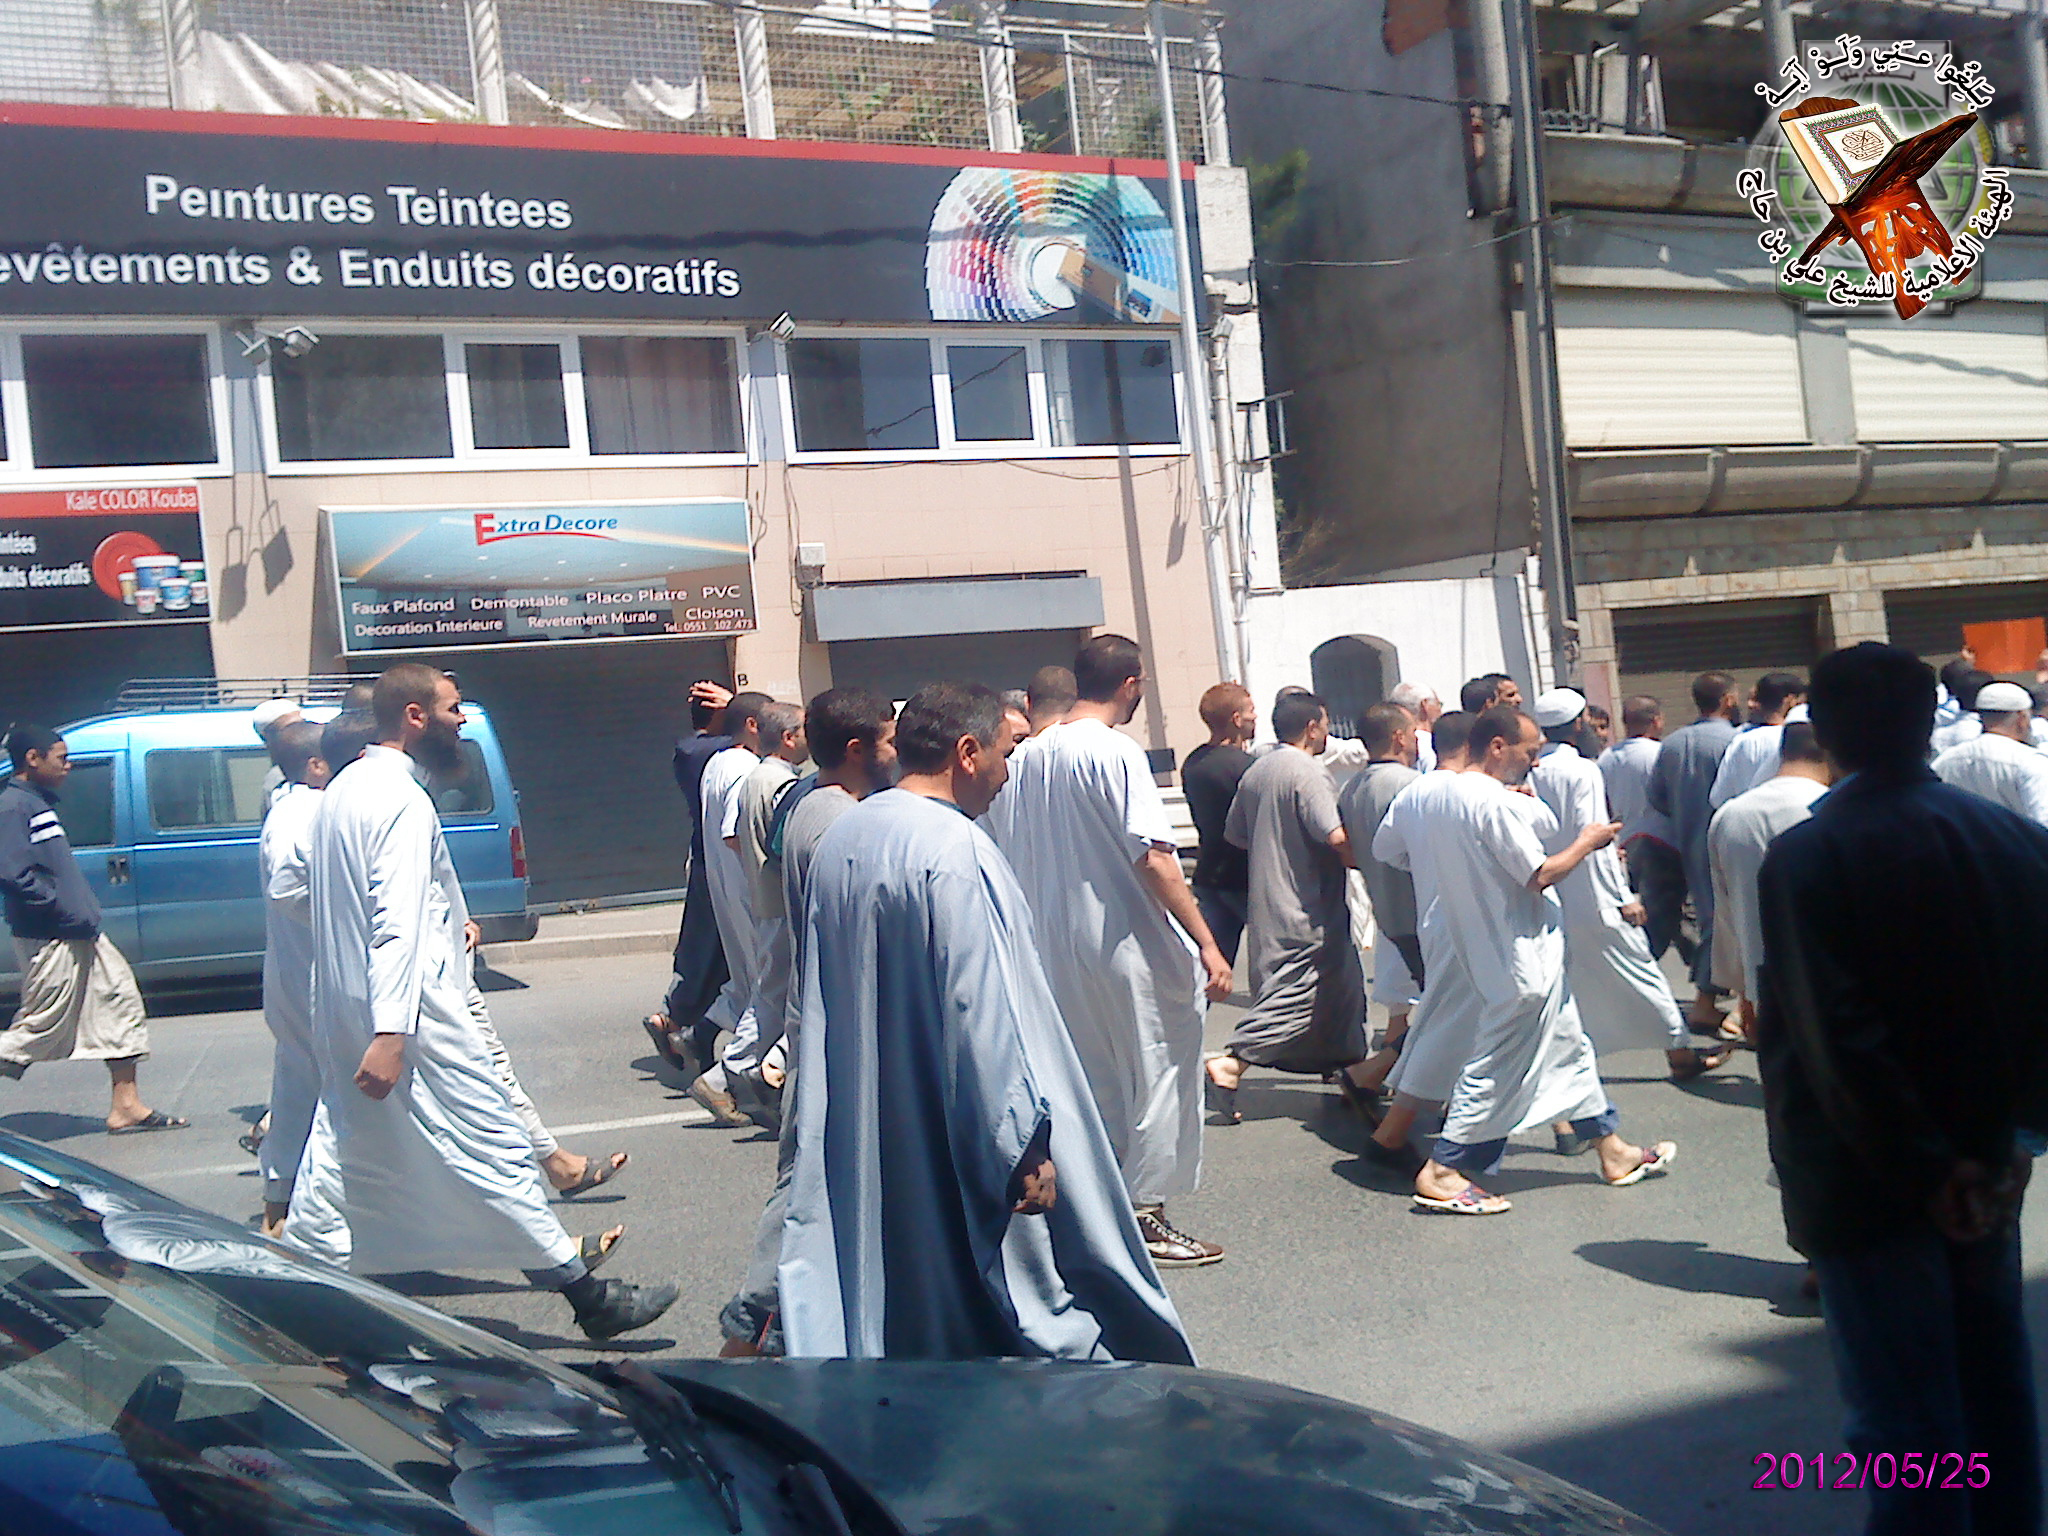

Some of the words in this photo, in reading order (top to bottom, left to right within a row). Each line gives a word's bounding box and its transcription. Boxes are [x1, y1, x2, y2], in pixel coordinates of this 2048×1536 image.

[145, 173, 375, 224] Peintures
[385, 185, 573, 230] Teintees
[286, 245, 323, 286] &
[338, 247, 516, 290] Enduits
[526, 252, 742, 298] décoratifs
[65, 491, 98, 511] Kale
[99, 489, 150, 510] COLOR
[150, 488, 197, 508] Kouba
[474, 513, 540, 546] Extra
[544, 513, 618, 531] Decore
[28, 561, 92, 587] décoratifs
[352, 601, 390, 615] Faux
[393, 597, 456, 614] Plafond
[471, 594, 569, 611] Demontable
[586, 590, 633, 604] Placo
[638, 588, 689, 602] Platre
[702, 584, 742, 599] PVC
[355, 620, 434, 637] Decoration
[435, 617, 504, 633] Interieure
[528, 613, 608, 629] Revetement
[611, 610, 658, 625] Murale
[685, 606, 746, 620] Cloison
[714, 618, 732, 631] 102
[738, 673, 749, 687] B
